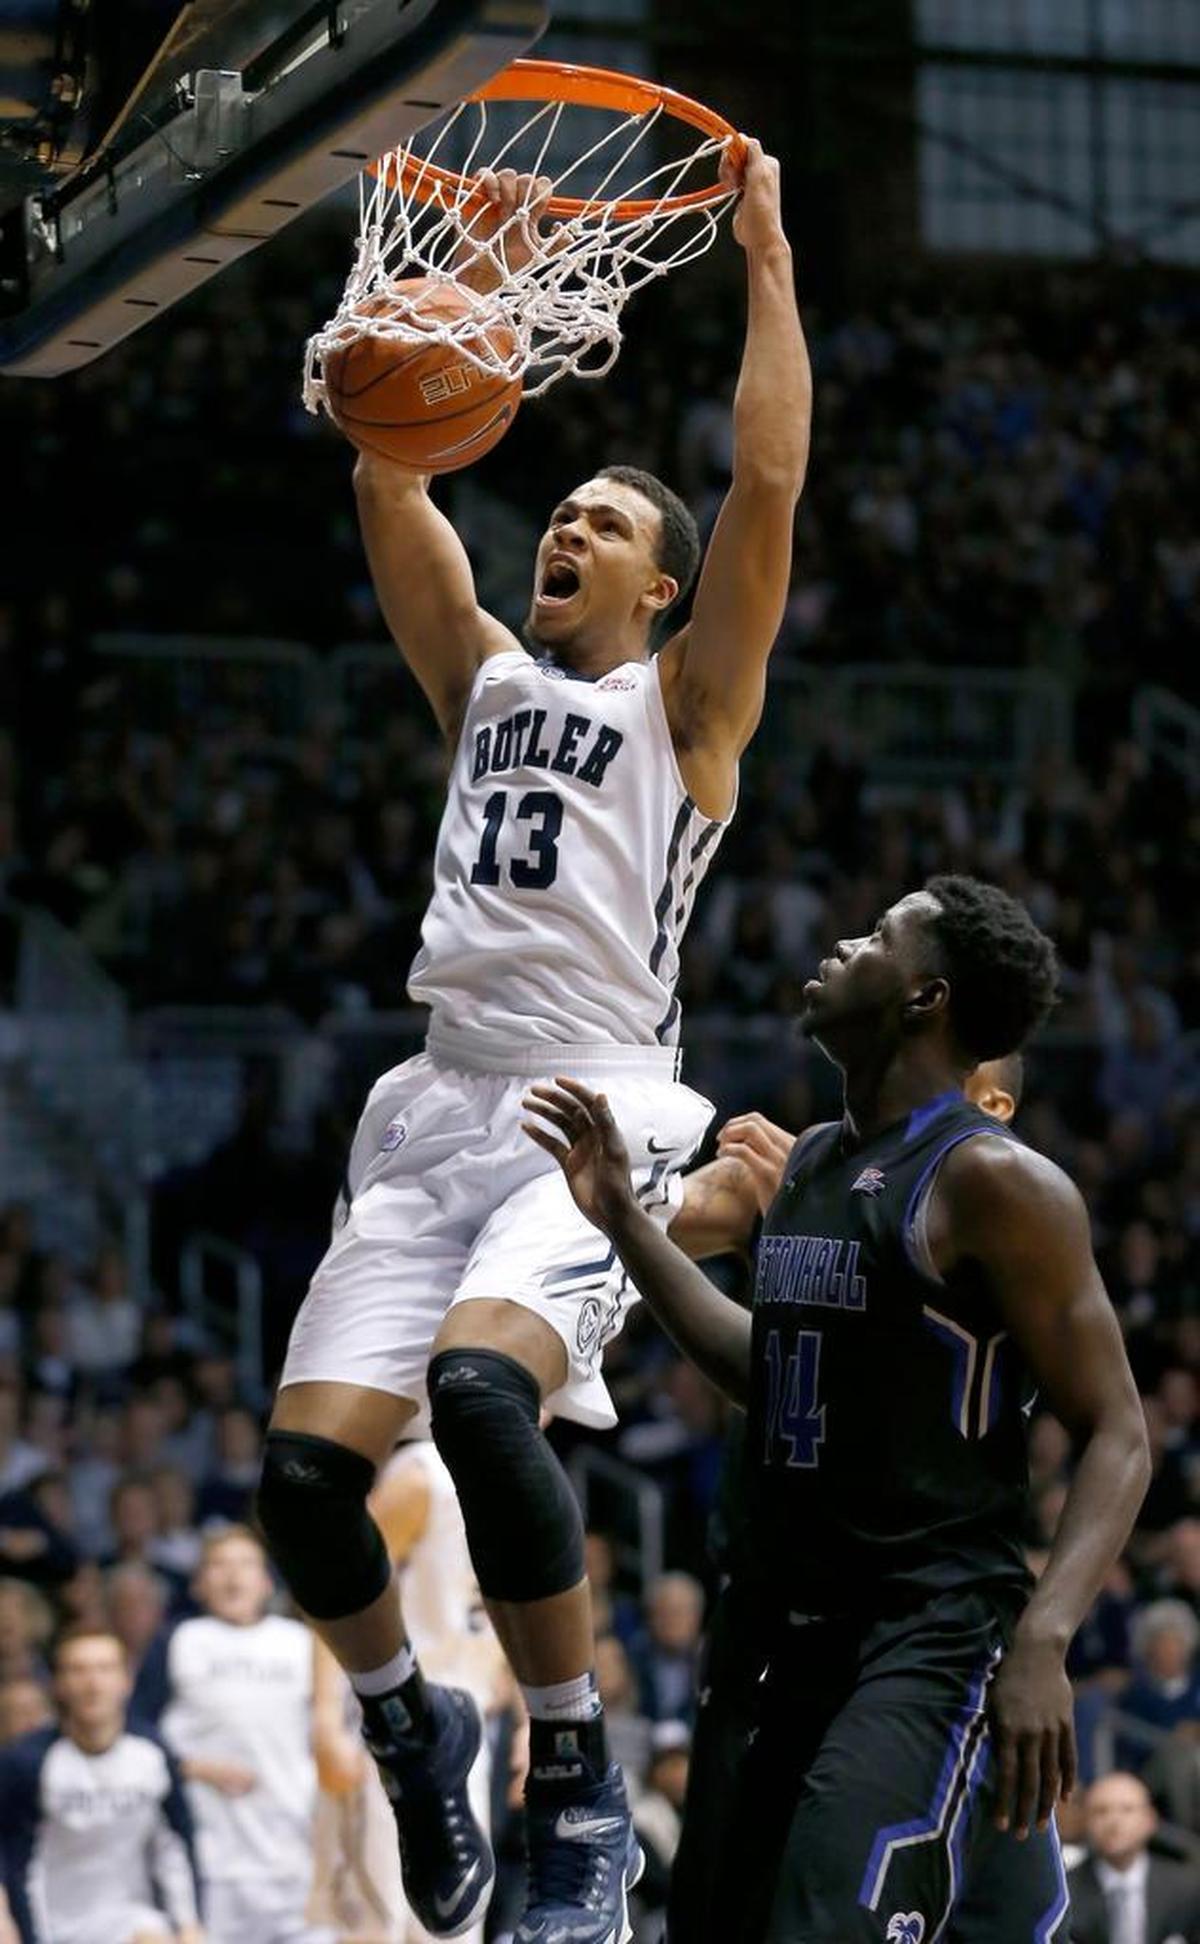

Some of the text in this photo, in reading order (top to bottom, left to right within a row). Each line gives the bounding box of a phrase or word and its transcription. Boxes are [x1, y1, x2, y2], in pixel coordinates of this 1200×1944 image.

[472, 709, 624, 788] BUTLER
[470, 791, 564, 890] 13
[763, 1329, 827, 1468] 14
